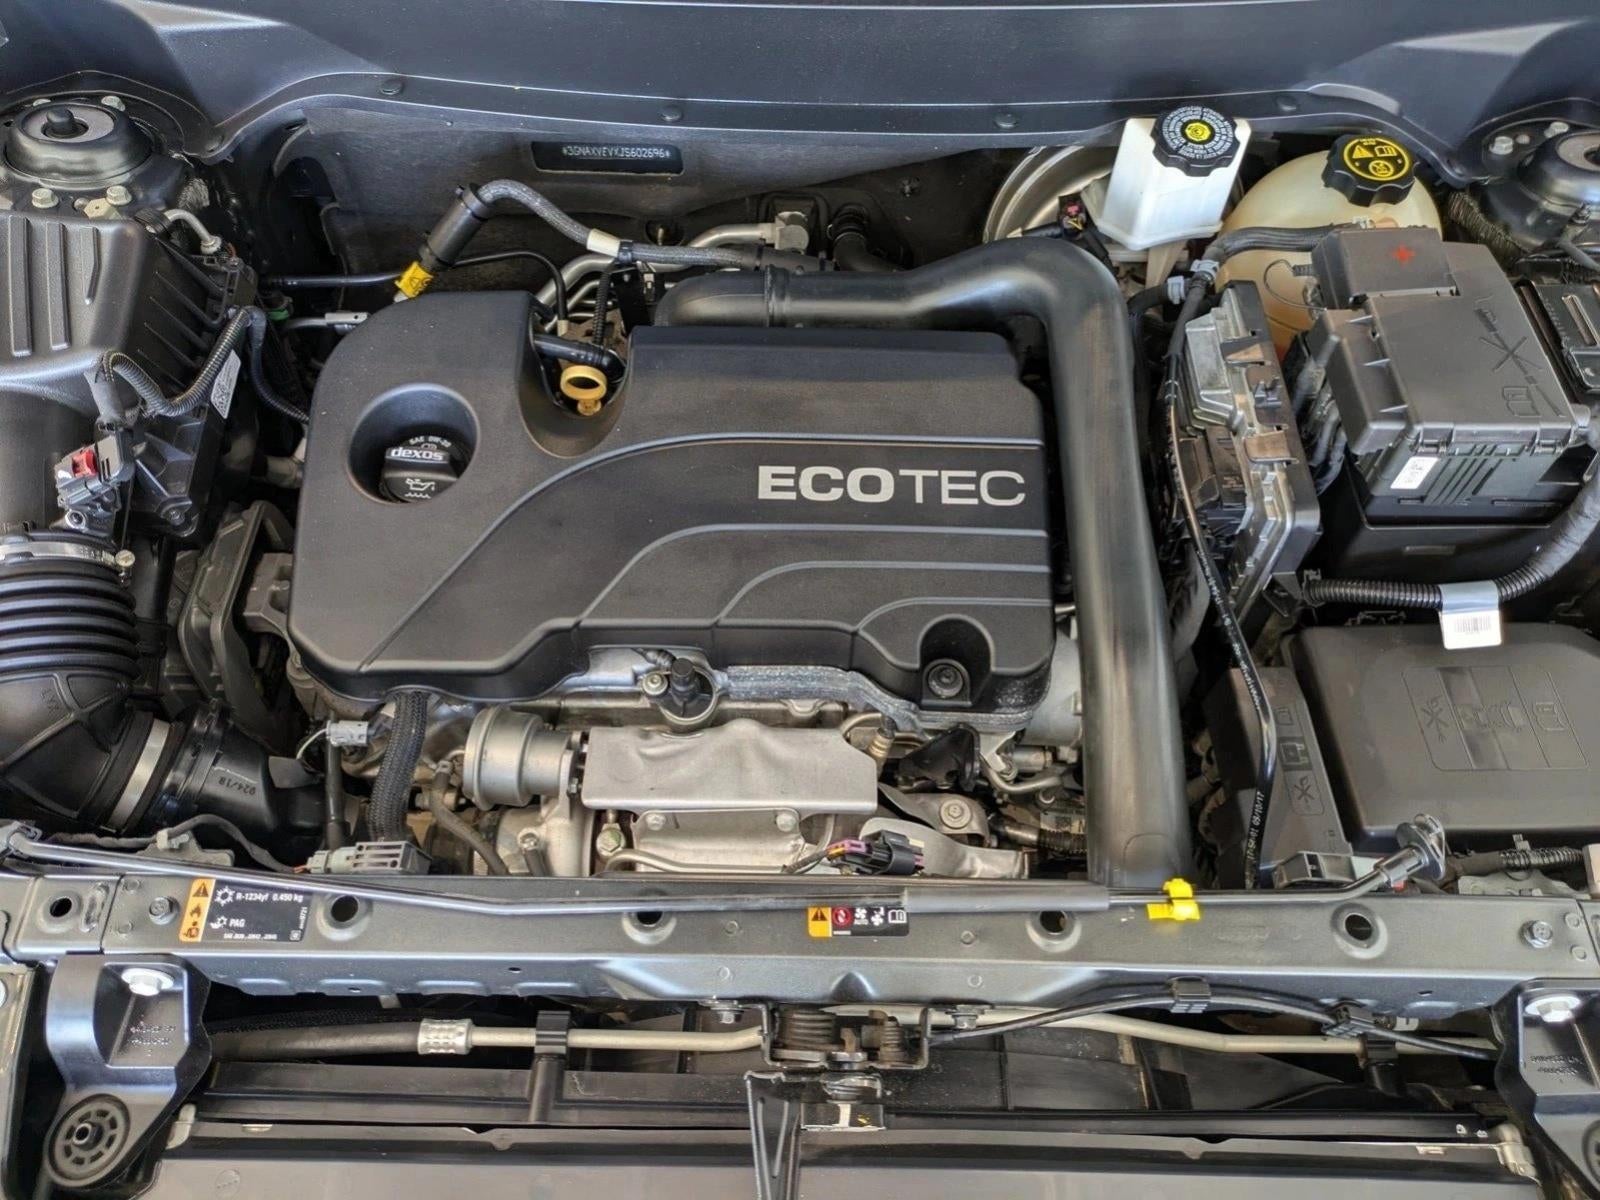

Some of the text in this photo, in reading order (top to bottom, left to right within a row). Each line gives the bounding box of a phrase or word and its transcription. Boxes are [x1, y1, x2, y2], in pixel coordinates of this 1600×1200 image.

[390, 446, 444, 461] dexos
[757, 465, 1026, 507] ECOTEC
[228, 918, 246, 928] PAG
